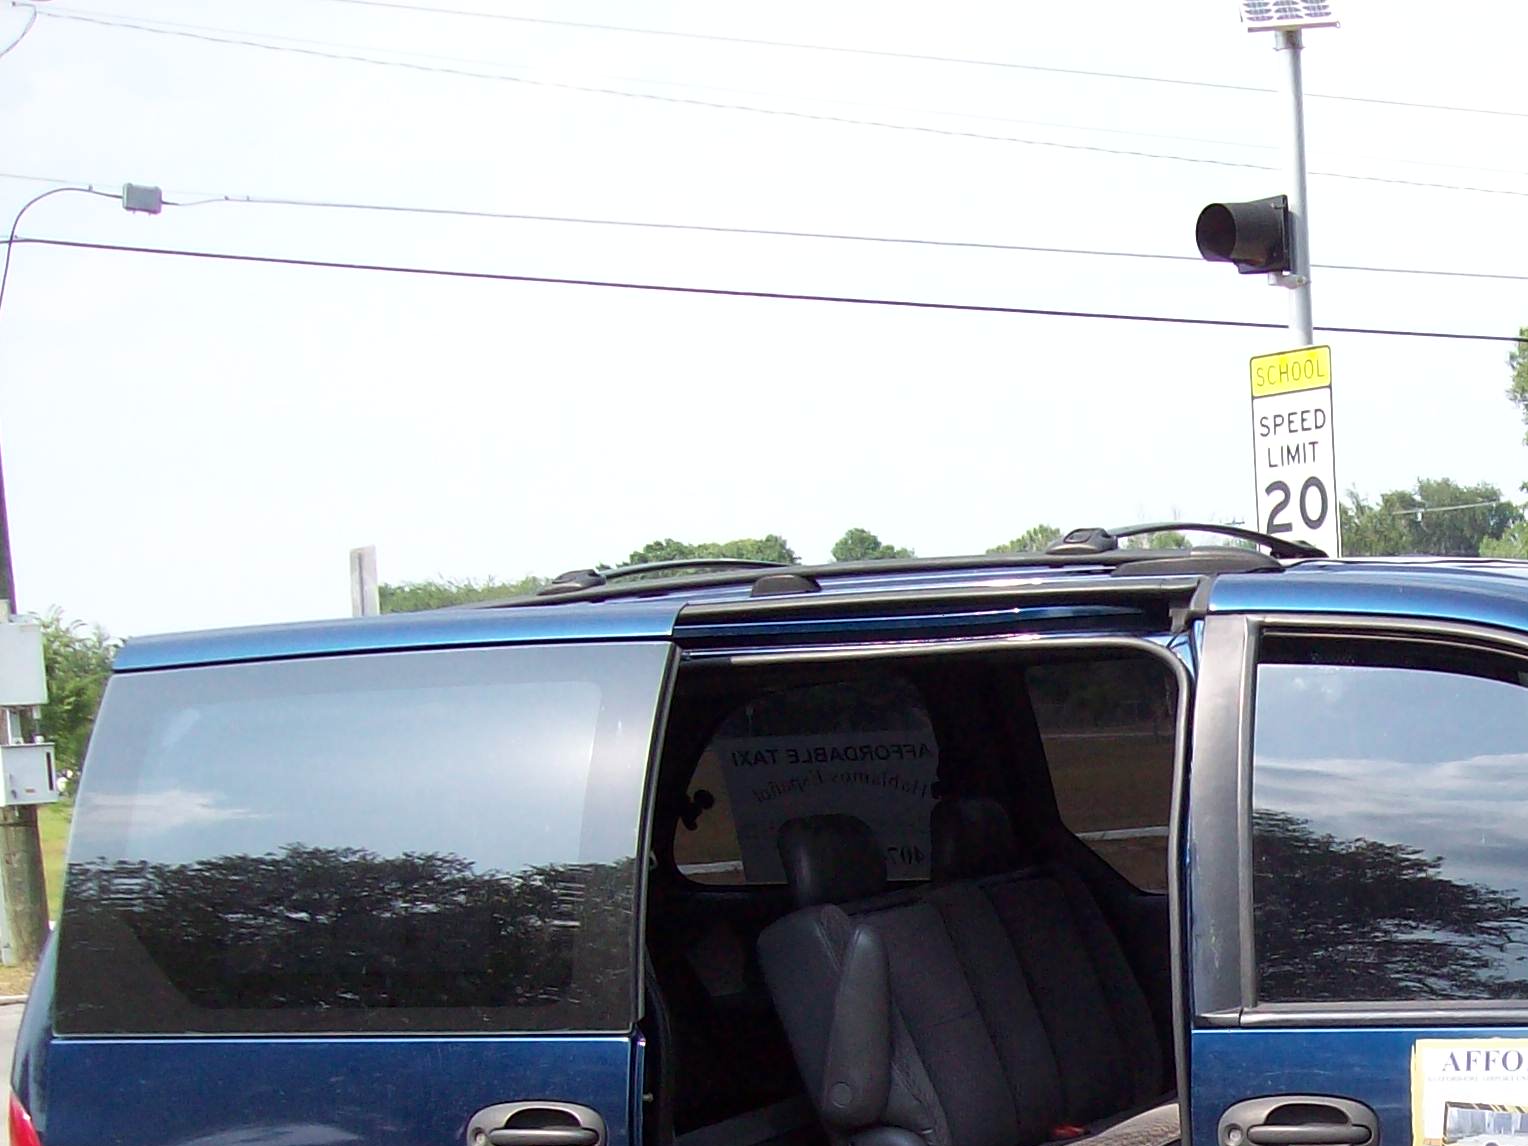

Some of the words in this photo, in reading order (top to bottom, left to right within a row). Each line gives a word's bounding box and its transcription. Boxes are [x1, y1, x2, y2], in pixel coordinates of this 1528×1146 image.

[1256, 358, 1326, 387] SCHOOL
[1259, 408, 1327, 437] SPEED
[1267, 441, 1319, 468] LIMIT
[1264, 476, 1329, 535] 20
